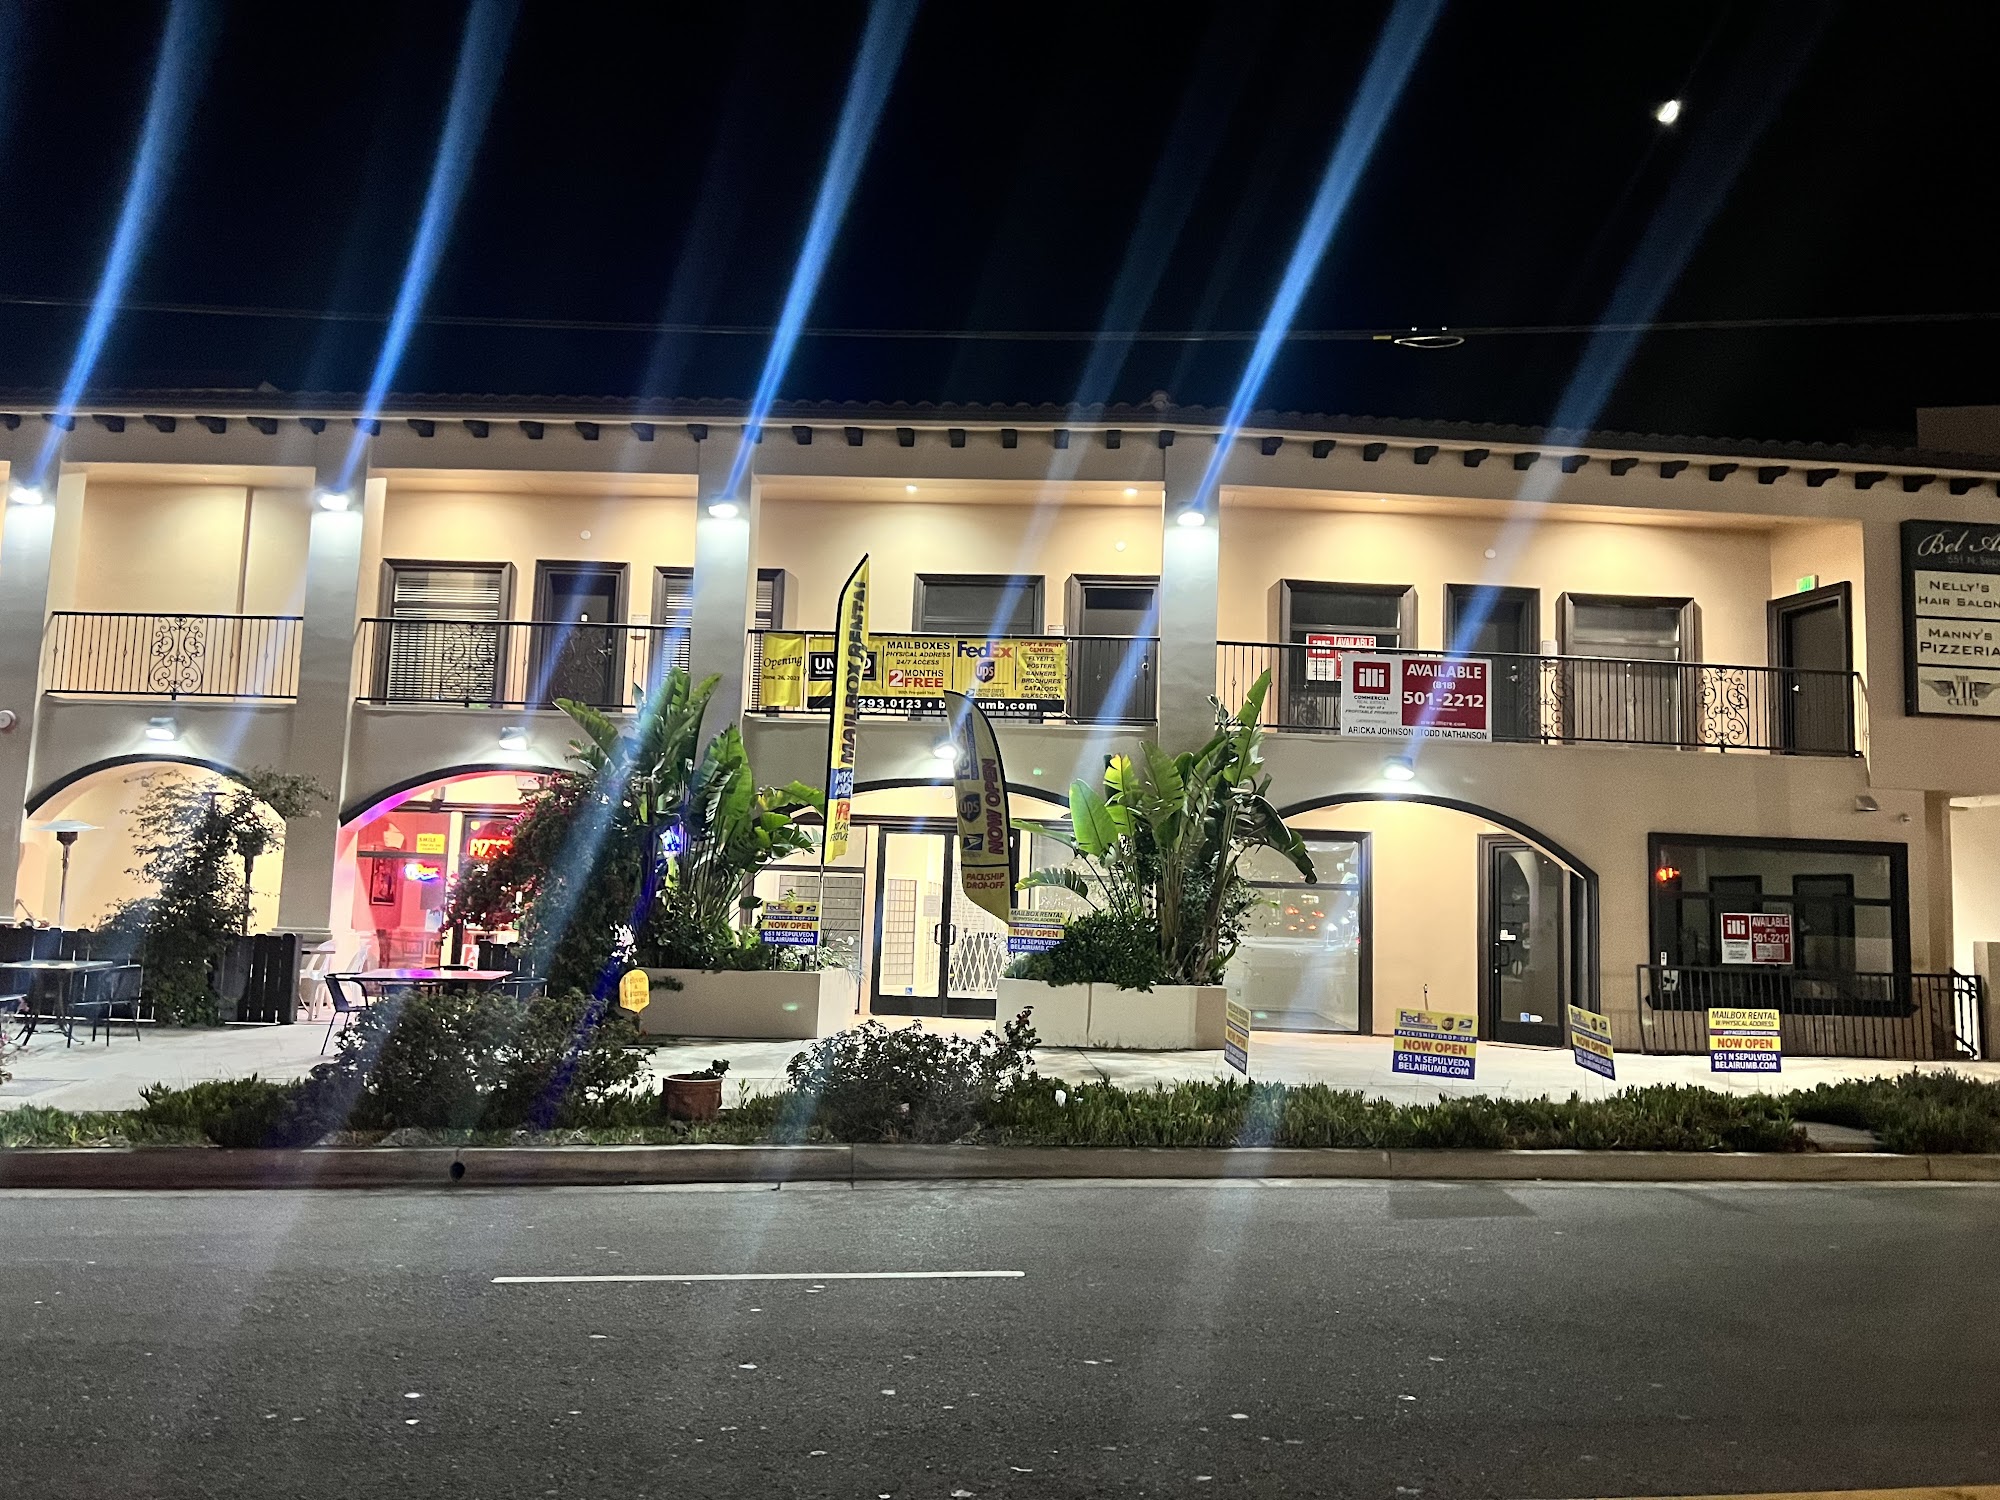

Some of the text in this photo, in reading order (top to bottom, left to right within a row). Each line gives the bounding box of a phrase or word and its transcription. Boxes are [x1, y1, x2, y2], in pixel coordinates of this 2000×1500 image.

[1917, 529, 1969, 557] Bel
[1929, 580, 1990, 593] NELLY'S
[1918, 596, 2000, 608] HAIR SALON
[1928, 628, 1993, 641] MANNY'S
[887, 641, 950, 650] MAILBOXES
[1337, 637, 1375, 647] AVAILABLE
[1920, 641, 2000, 656] PIZZERIA
[957, 640, 1013, 658] FedEx
[763, 654, 803, 669] Opening
[904, 669, 944, 677] MONTHS
[976, 664, 994, 680] ups
[1358, 667, 1385, 688] illi
[1406, 663, 1482, 679] AVAILABLE
[889, 669, 904, 687] 2
[904, 677, 944, 688] FREE
[1433, 680, 1456, 690] (818)
[1403, 691, 1484, 708] 501-2212
[841, 660, 862, 764] MAILBOX
[1347, 726, 1487, 740] ARICKA JOHNSON TODD NATHANSON
[960, 800, 980, 819] ups
[981, 758, 1004, 855] NOW OPEN
[966, 881, 1006, 889] DROP-OFF
[768, 921, 813, 930] NOW OPEN
[1727, 919, 1746, 935] illi
[1751, 916, 1790, 928] AVAILABLE
[1013, 928, 1059, 938] NOW OPEN
[1752, 933, 1790, 944] 501-2212
[1027, 938, 1060, 946] SEPULVEDA
[1400, 1011, 1433, 1025] FedEx
[1711, 1010, 1777, 1020] MAILBOX RENTAL
[1403, 1039, 1468, 1056] NOW OPEN
[1717, 1038, 1773, 1049] NOW OPEN
[1397, 1053, 1471, 1068] 651 N SEPULVEDA
[1735, 1053, 1777, 1061] SEPULVEDA
[1398, 1061, 1470, 1076] BELAIRUMB.COM
[1714, 1061, 1777, 1070] BELAIRUMB.COM
